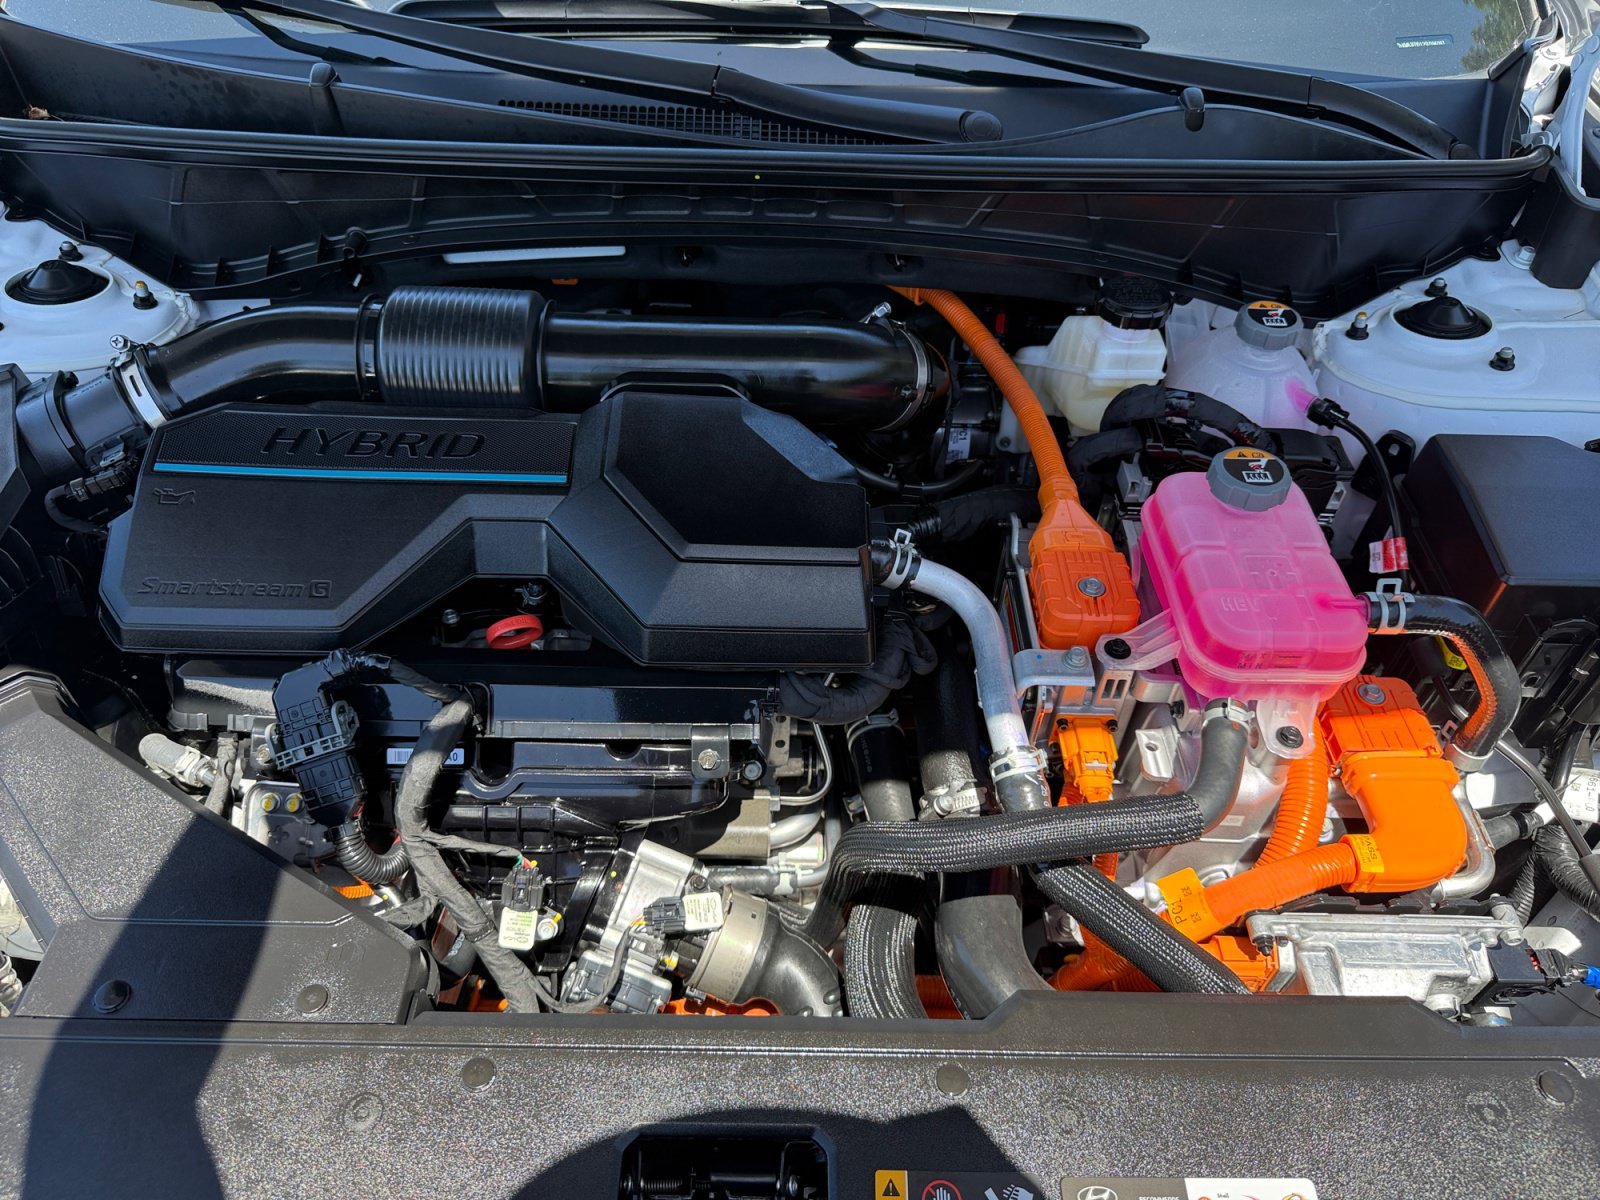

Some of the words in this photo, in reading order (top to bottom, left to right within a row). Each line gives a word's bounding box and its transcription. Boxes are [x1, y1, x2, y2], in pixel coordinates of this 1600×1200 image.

[260, 427, 486, 459] HYBRID
[137, 576, 305, 598] Smartstream
[309, 579, 332, 598] G
[1240, 652, 1267, 660] MAX
[1237, 662, 1263, 670] MIN
